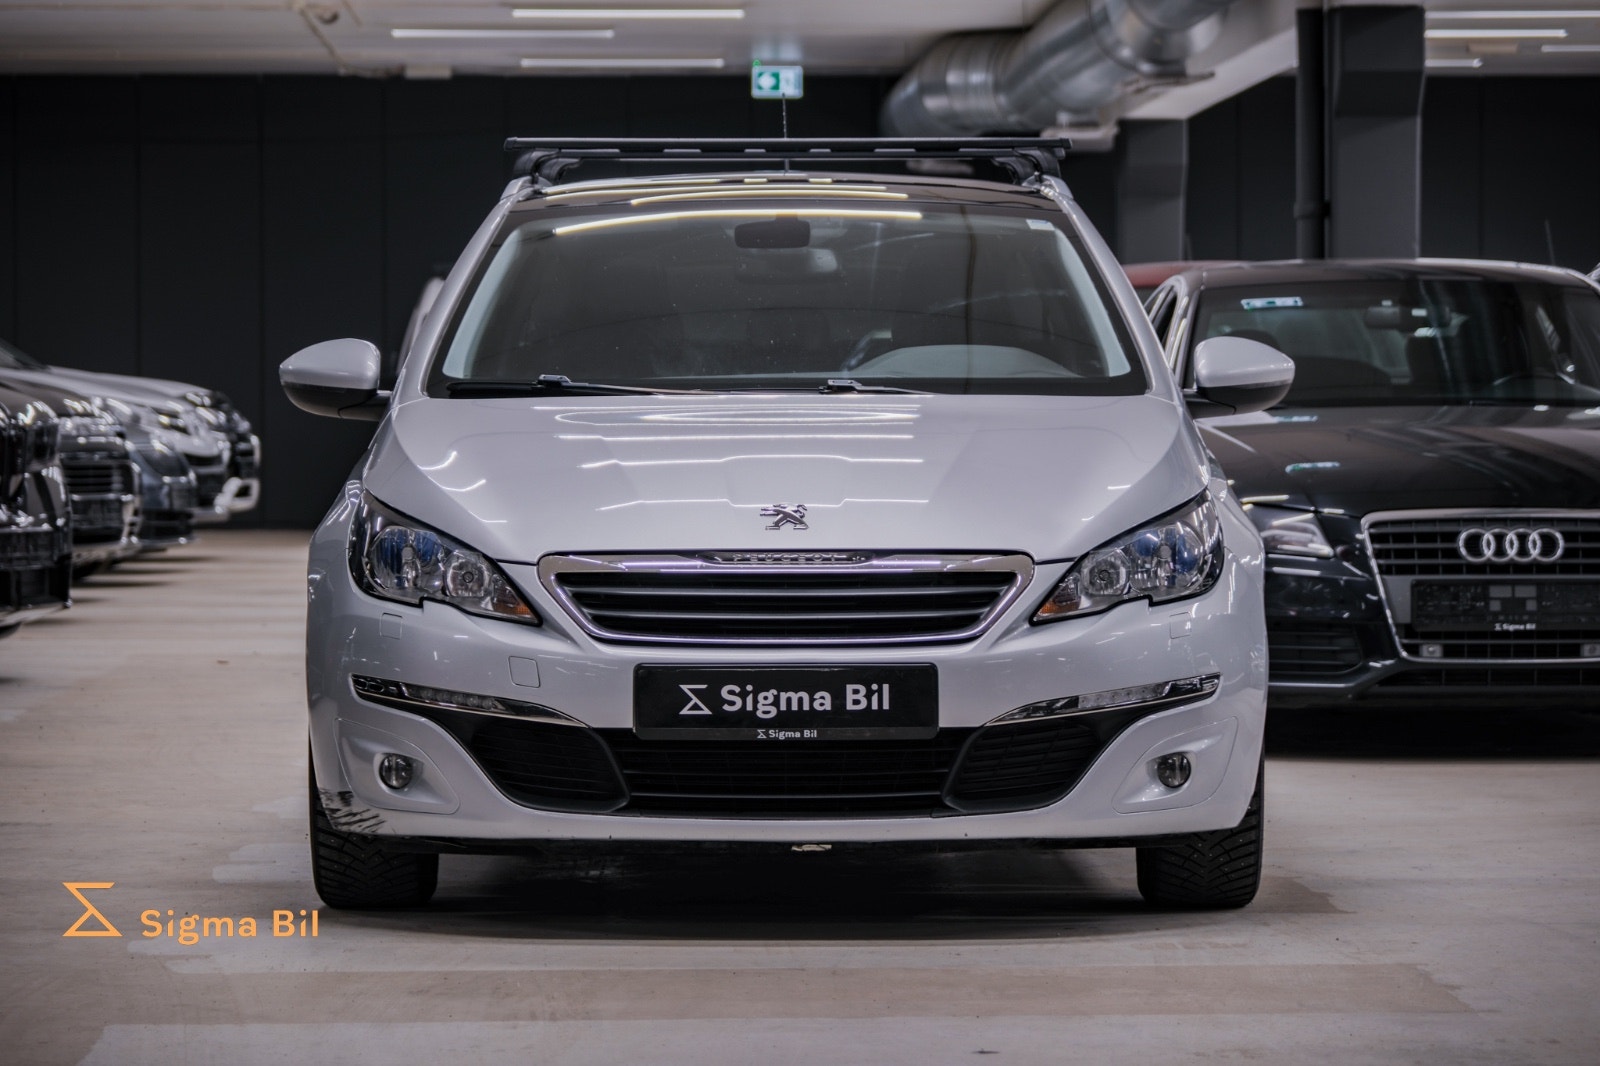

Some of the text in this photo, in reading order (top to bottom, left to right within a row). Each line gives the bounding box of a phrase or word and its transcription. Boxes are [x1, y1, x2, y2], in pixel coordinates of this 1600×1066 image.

[732, 553, 840, 564] PEUGEOT
[720, 683, 890, 719] Sigma Bil
[768, 729, 818, 740] Sigma Bil
